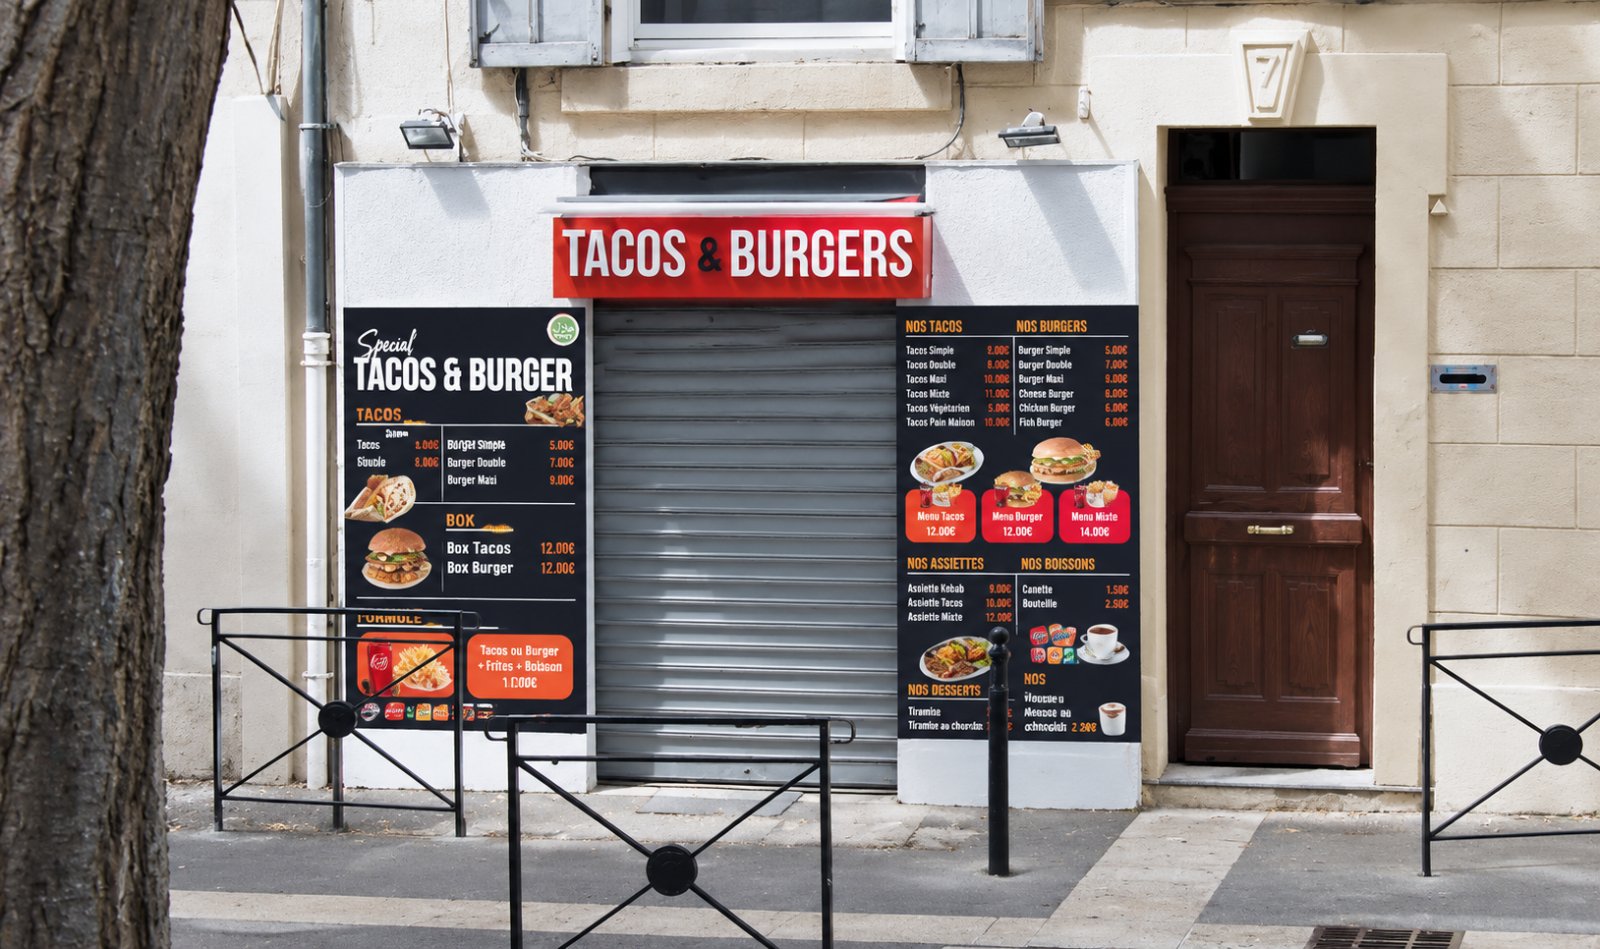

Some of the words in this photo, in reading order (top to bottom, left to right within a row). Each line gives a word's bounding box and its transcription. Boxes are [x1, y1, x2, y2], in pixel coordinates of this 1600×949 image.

[562, 228, 687, 278] TACOS
[697, 236, 722, 273] &
[730, 228, 914, 278] BURGERS
[906, 320, 926, 332] NOS
[928, 319, 964, 333] TACOS
[1017, 320, 1037, 332] NOS
[1039, 319, 1088, 333] BURGERS
[357, 328, 418, 358] Special
[906, 346, 927, 355] Tacos
[929, 346, 954, 356] Simple
[1019, 346, 1044, 356] Burger
[1046, 345, 1070, 356] Simple
[1105, 345, 1127, 354] 5.00€
[907, 360, 927, 369] Tacos
[929, 360, 956, 369] Double
[1019, 360, 1044, 371] Burger
[1106, 360, 1127, 369] 7.00€
[353, 356, 437, 391] TACOS
[443, 356, 462, 391] &
[470, 357, 572, 391] BURGER
[906, 375, 928, 383] Tacos
[930, 374, 946, 383] Maxi
[985, 374, 1009, 383] 10.00€
[1019, 374, 1044, 385] Burger
[906, 389, 928, 398] Tacos
[930, 389, 950, 398] Mixte
[986, 389, 1009, 398] 11.00€
[1049, 389, 1074, 400] Burger
[907, 404, 928, 412] Tacos
[989, 403, 1009, 412] 5.00€
[1105, 403, 1128, 412] 6.00€
[356, 407, 402, 422] TACOS
[907, 418, 928, 426] Tacos
[930, 417, 946, 426] Pain
[985, 417, 1009, 426] 10.00€
[1037, 417, 1062, 428] Burger
[1105, 417, 1128, 426] 6.00€
[550, 440, 574, 450] 5.00€
[478, 457, 506, 467] Double
[550, 457, 574, 467] 7.00€
[448, 475, 475, 486] Burger
[550, 475, 574, 485] 9.00€
[447, 514, 474, 527] BOX
[941, 512, 965, 521] Tacos
[1015, 512, 1043, 523] Burger
[1071, 512, 1093, 521] Menu
[926, 527, 956, 537] 12.00€
[1003, 527, 1033, 537] 12.00€
[1080, 527, 1110, 537] 14.00€
[447, 542, 469, 554] Box
[473, 542, 511, 554] Tacos
[541, 542, 574, 554] 12.00€
[448, 561, 468, 573] Box
[473, 561, 513, 576] Burger
[541, 562, 574, 574] 12.00€
[908, 557, 927, 569] NOS
[931, 557, 984, 569] ASSIETTES
[1022, 558, 1042, 570] NOS
[1045, 558, 1095, 570] BOISSONS
[989, 584, 1011, 593] 9.00€
[1023, 585, 1052, 594] Canette
[1107, 585, 1128, 594] 1.50€
[941, 598, 963, 607] Tacos
[986, 598, 1011, 607] 10.00€
[1106, 599, 1128, 608] 2.50€
[986, 612, 1012, 622] 12.00€
[480, 645, 508, 655] Tacos
[511, 647, 522, 656] ou
[526, 645, 559, 658] Burger
[486, 660, 513, 671] Frites
[1024, 673, 1045, 684] NOS
[908, 684, 928, 695] NOS
[932, 684, 980, 696] DESSERTS
